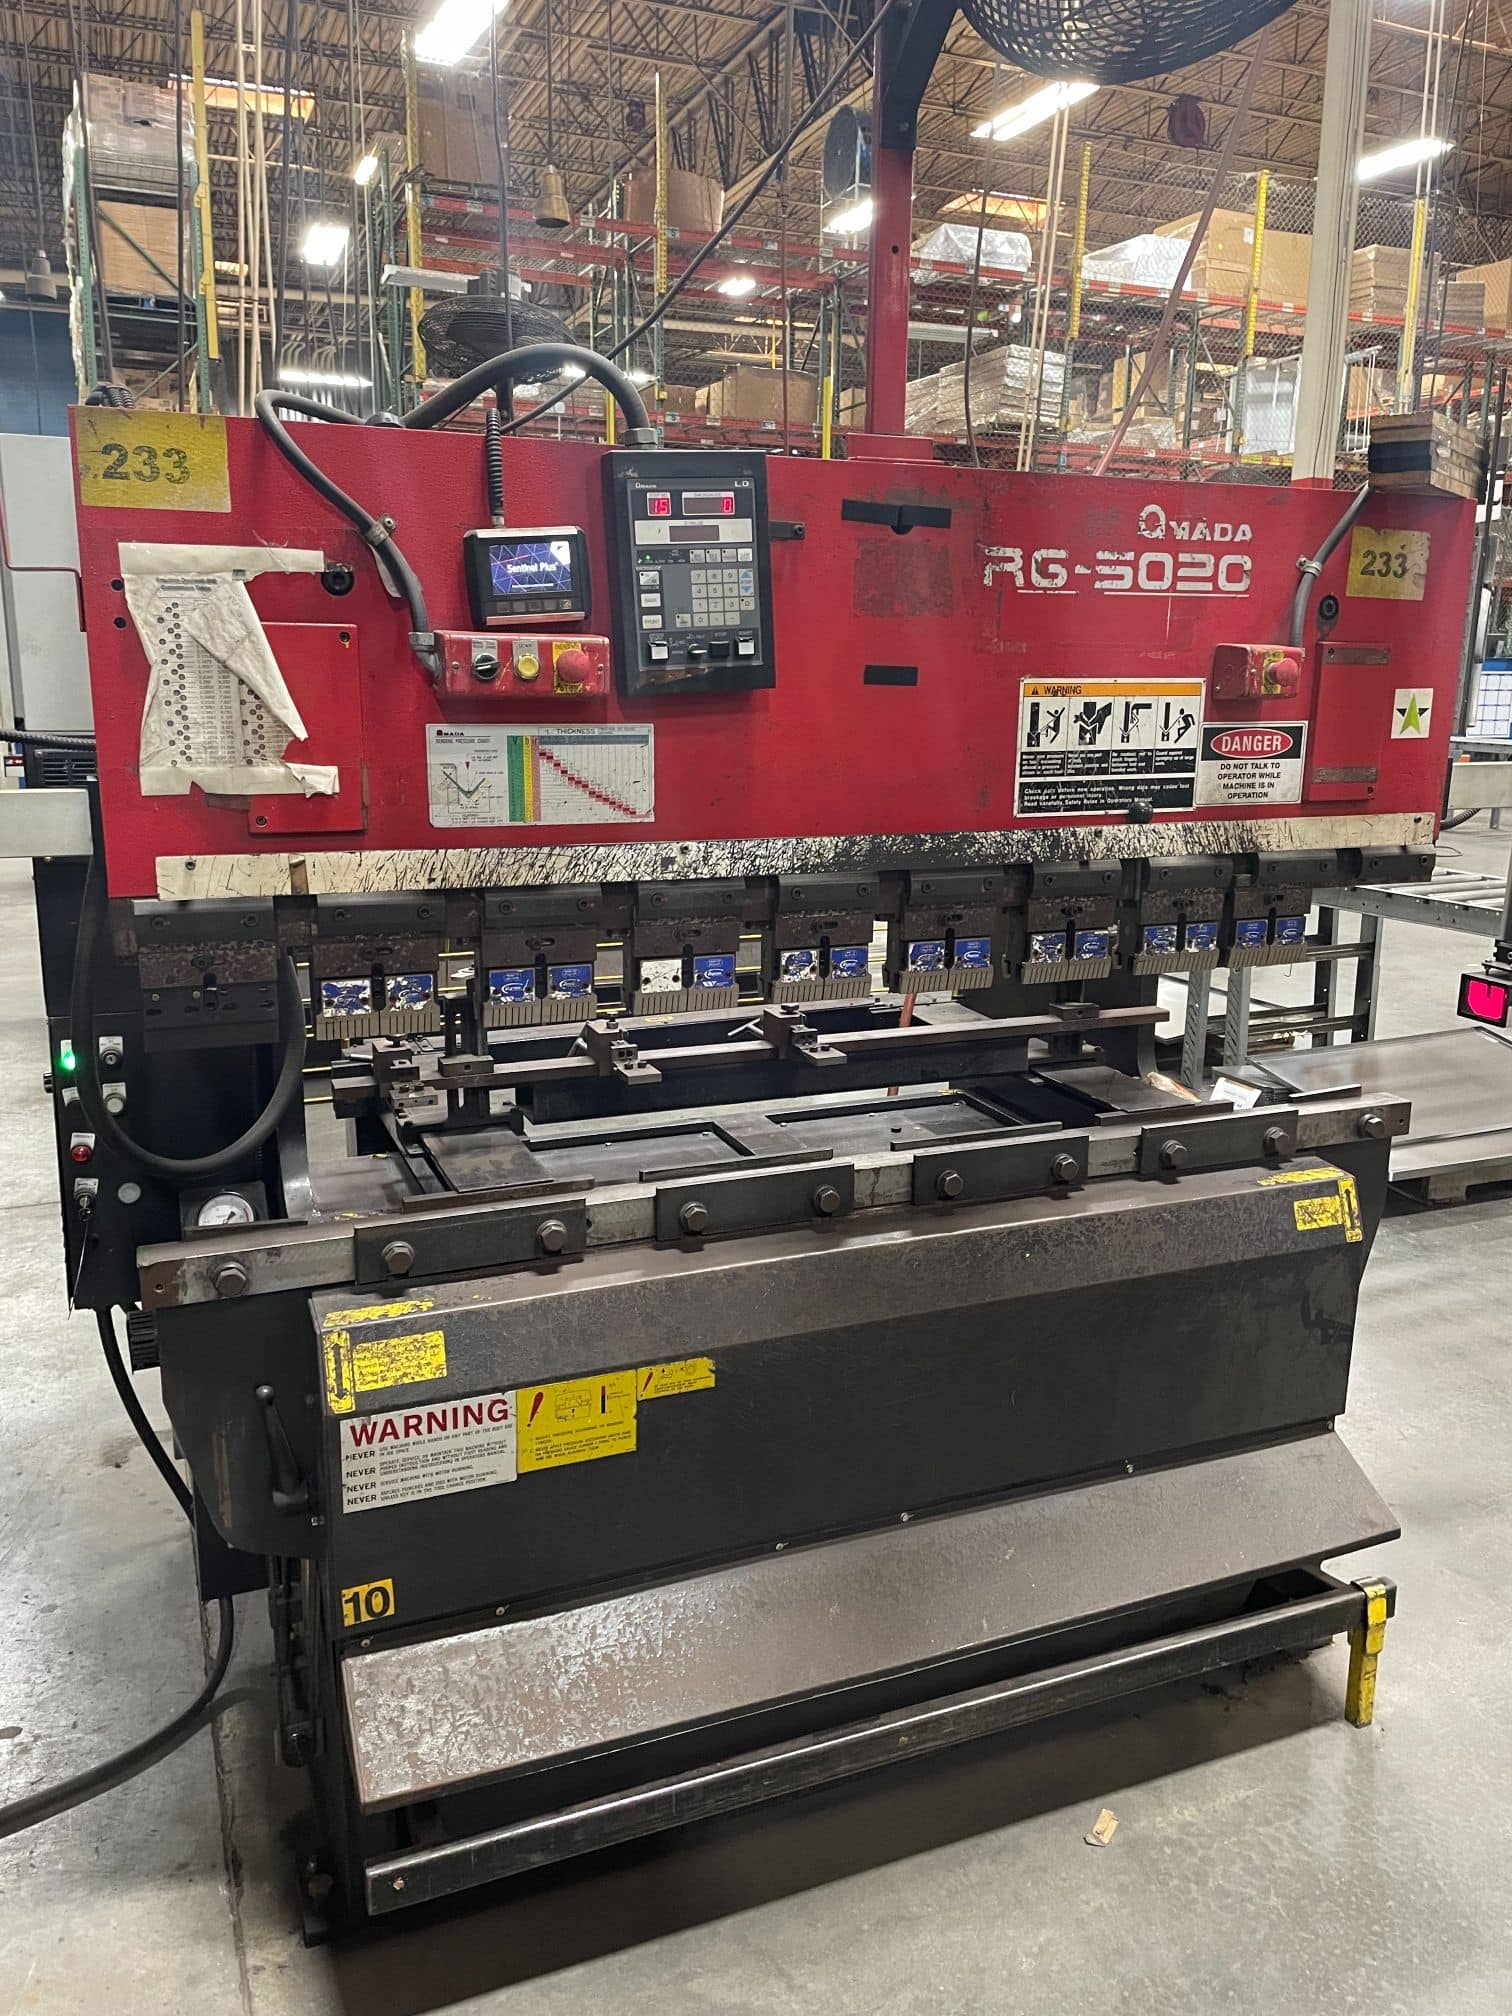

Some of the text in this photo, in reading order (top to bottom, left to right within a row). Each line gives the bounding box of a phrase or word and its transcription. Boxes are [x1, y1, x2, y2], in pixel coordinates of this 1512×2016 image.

[101, 443, 190, 484] 233
[507, 563, 538, 573] Sentinel
[983, 547, 1252, 591] RG-5020
[1360, 550, 1408, 578] 233
[1043, 685, 1082, 694] WARNING
[1221, 736, 1282, 751] DANGER
[1250, 762, 1268, 770] TALK
[1217, 772, 1257, 780] OPERATOR
[1222, 782, 1257, 790] MACHINE
[1227, 791, 1269, 799] OPERATION
[350, 1398, 509, 1447] WARNING
[345, 1450, 376, 1462] NEVER
[346, 1467, 376, 1478] NEVER
[346, 1482, 377, 1493] NEVER
[347, 1494, 377, 1506] NEVER
[344, 1586, 390, 1622] 10
